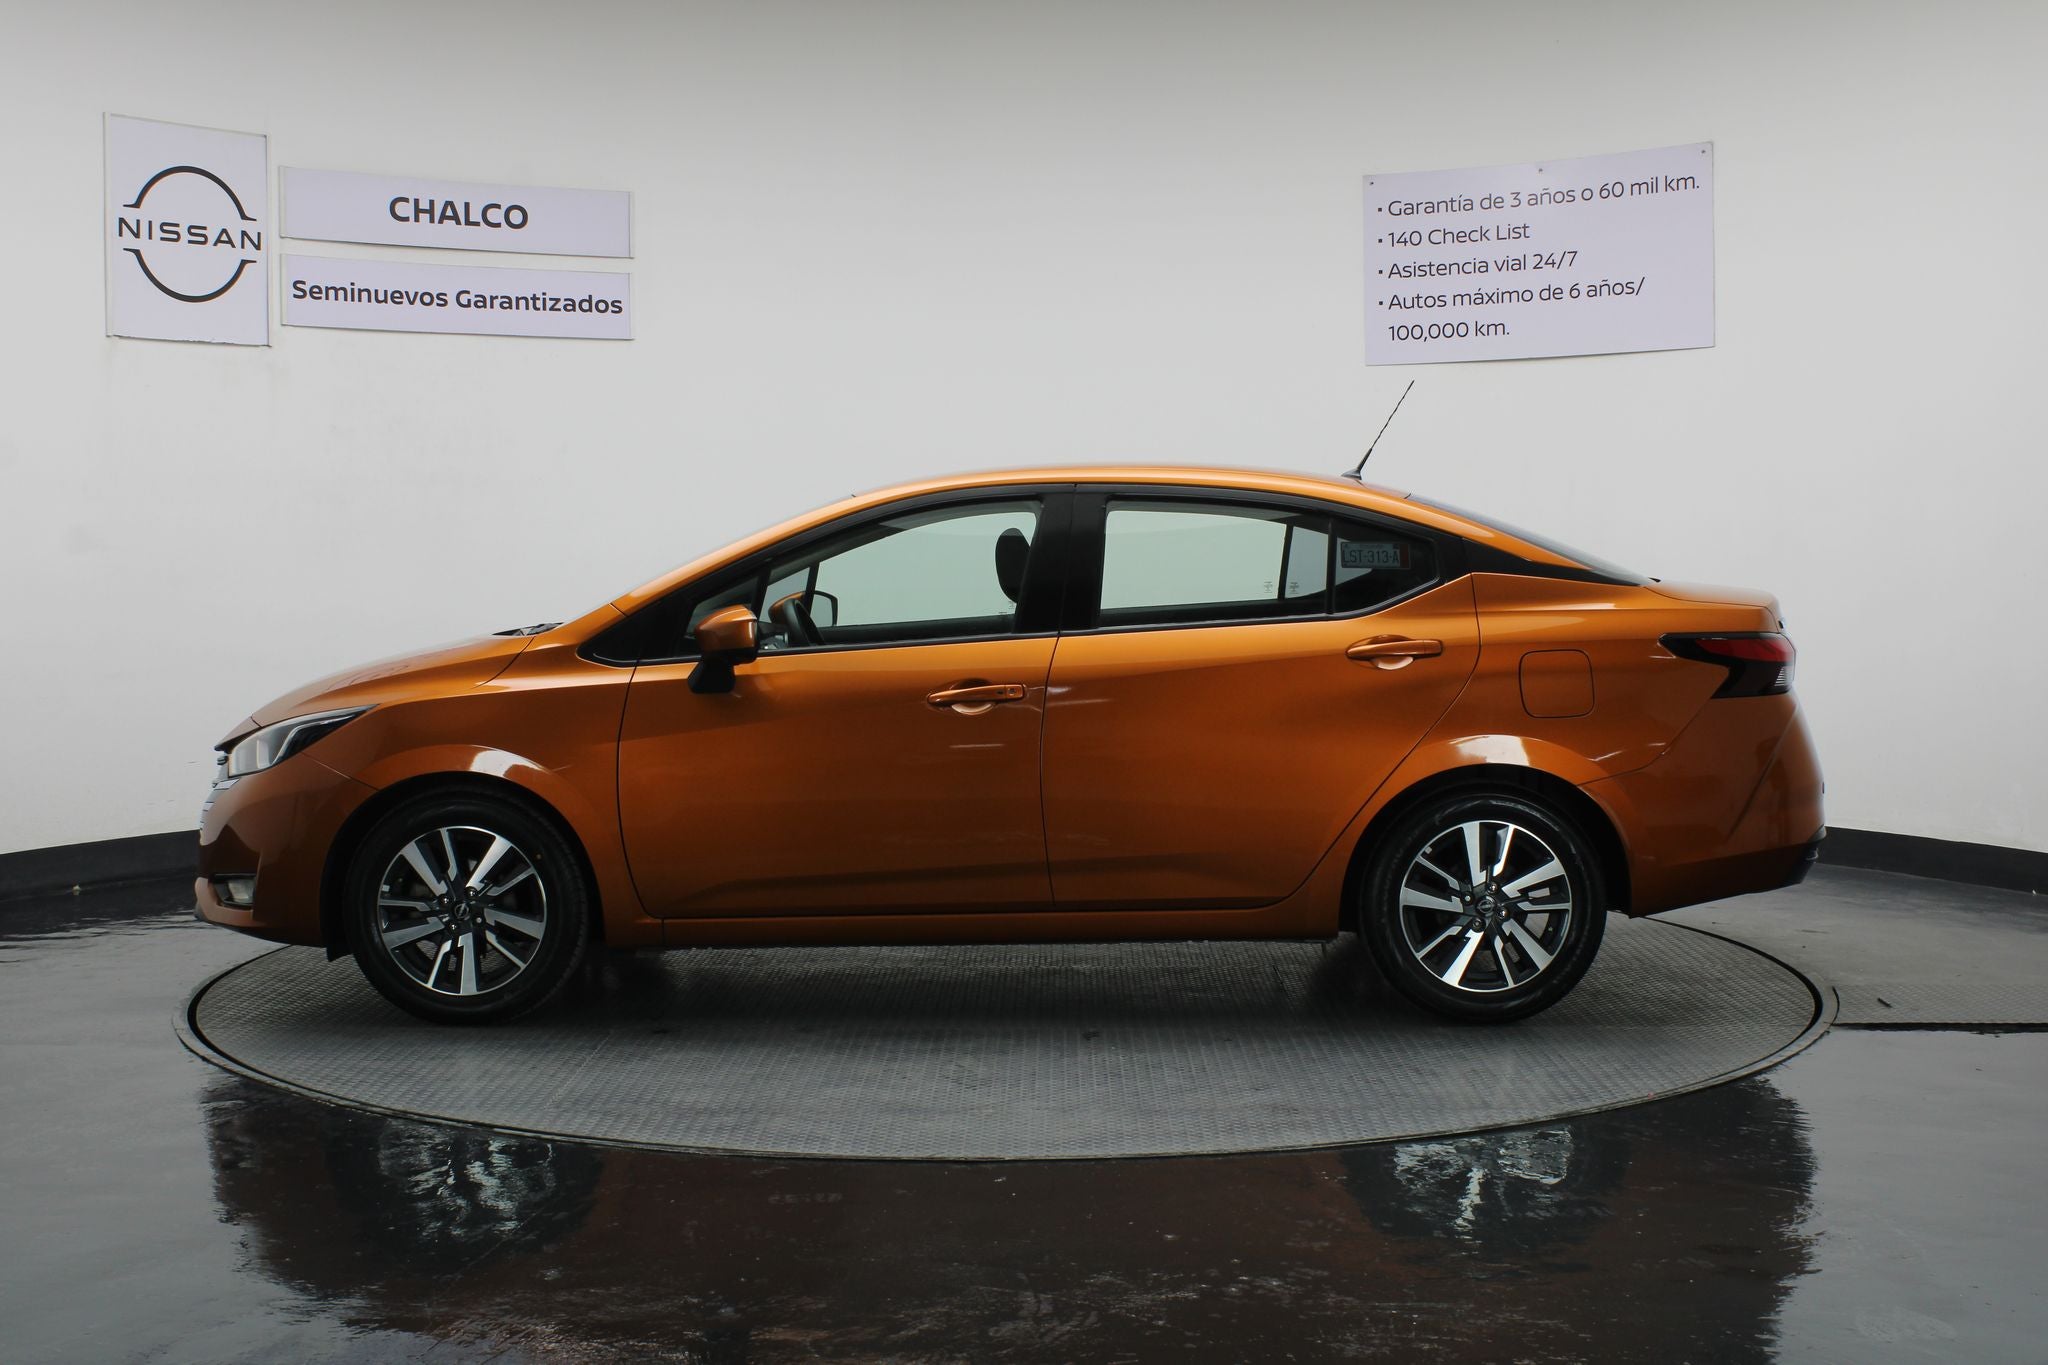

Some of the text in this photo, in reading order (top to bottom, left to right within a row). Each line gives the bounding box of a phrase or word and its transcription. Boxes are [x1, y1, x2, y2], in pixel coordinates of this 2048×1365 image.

[1388, 176, 1699, 216] Garantía de 3 años o 60 mil km.
[389, 197, 528, 229] CHALCO
[118, 217, 261, 251] NISSAN
[1388, 224, 1530, 247] 140 Check List
[1388, 251, 1577, 279] Asistencia vial 24/7
[293, 280, 623, 314] Seminuevos Garantizados
[1389, 277, 1645, 310] Autos máximo de 6 años/
[1388, 321, 1509, 342] 100,000 km.
